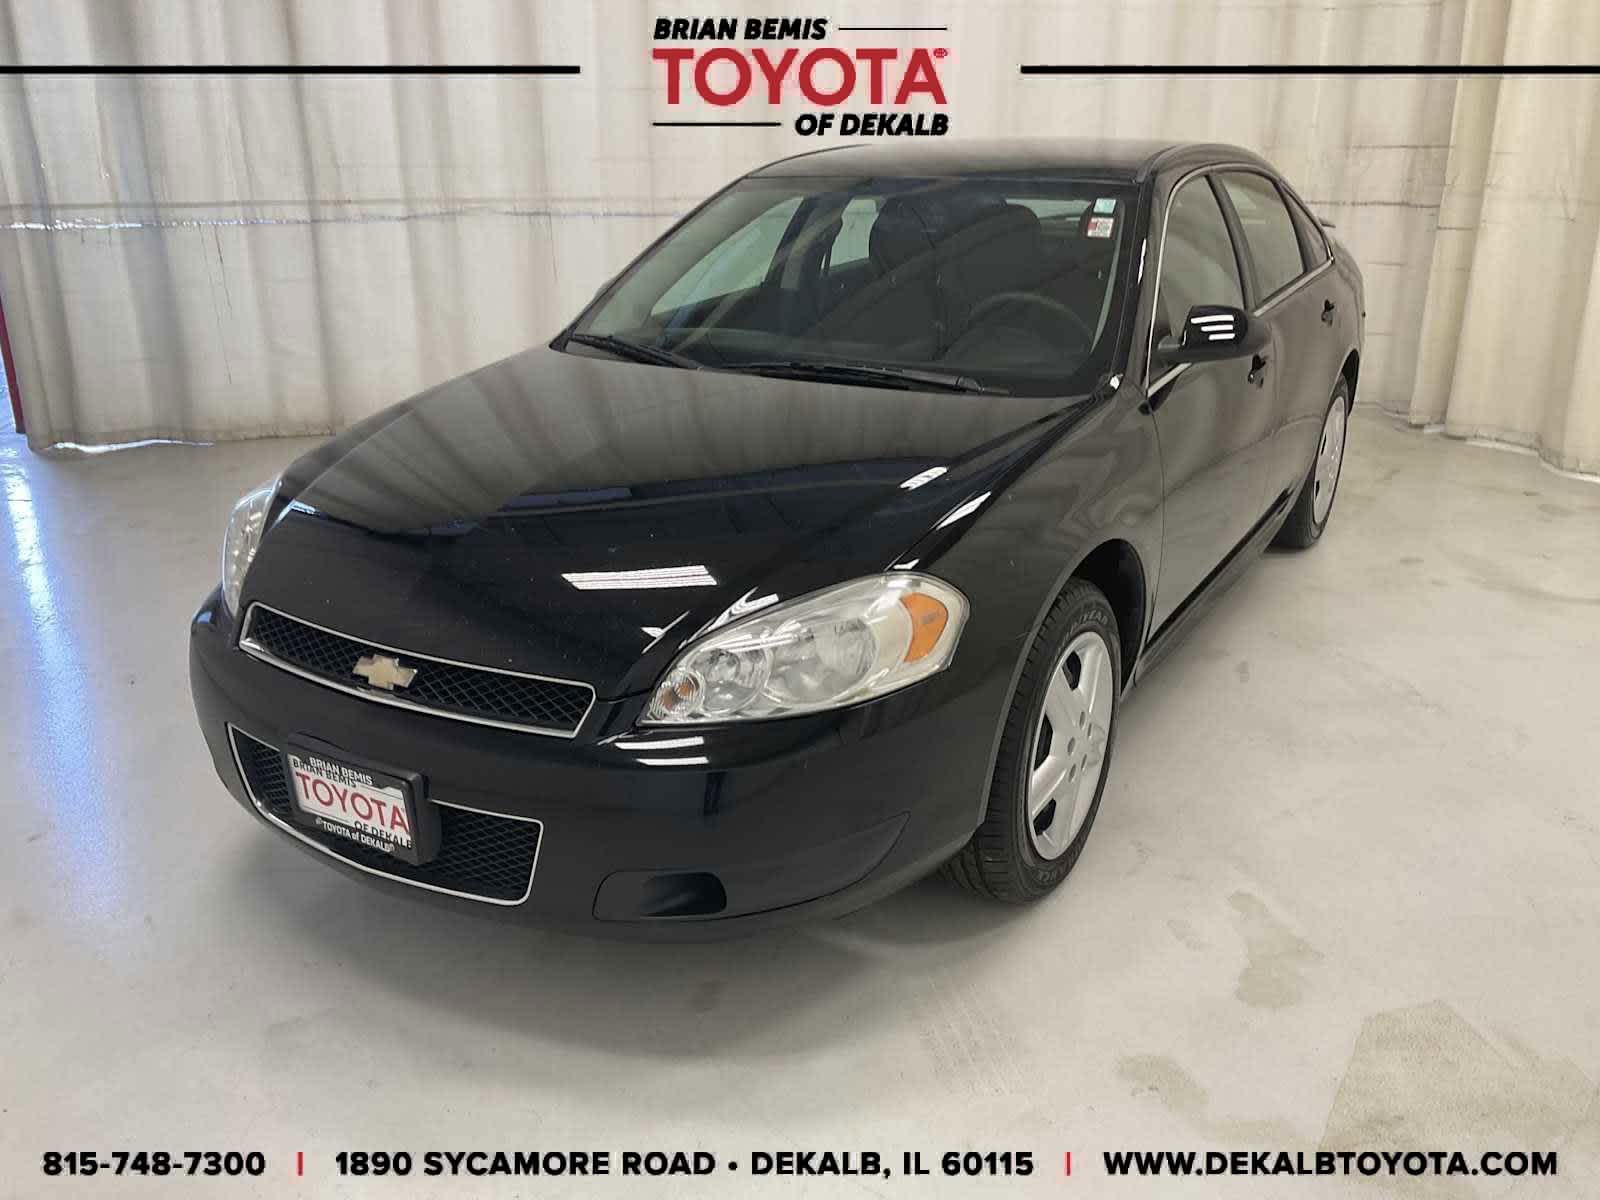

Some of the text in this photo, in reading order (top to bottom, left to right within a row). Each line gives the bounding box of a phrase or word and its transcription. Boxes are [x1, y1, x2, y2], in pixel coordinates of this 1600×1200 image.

[309, 756, 373, 786] BRIAN BEMIS
[295, 771, 410, 833] TOYOTA
[323, 821, 351, 839] TOYOTA
